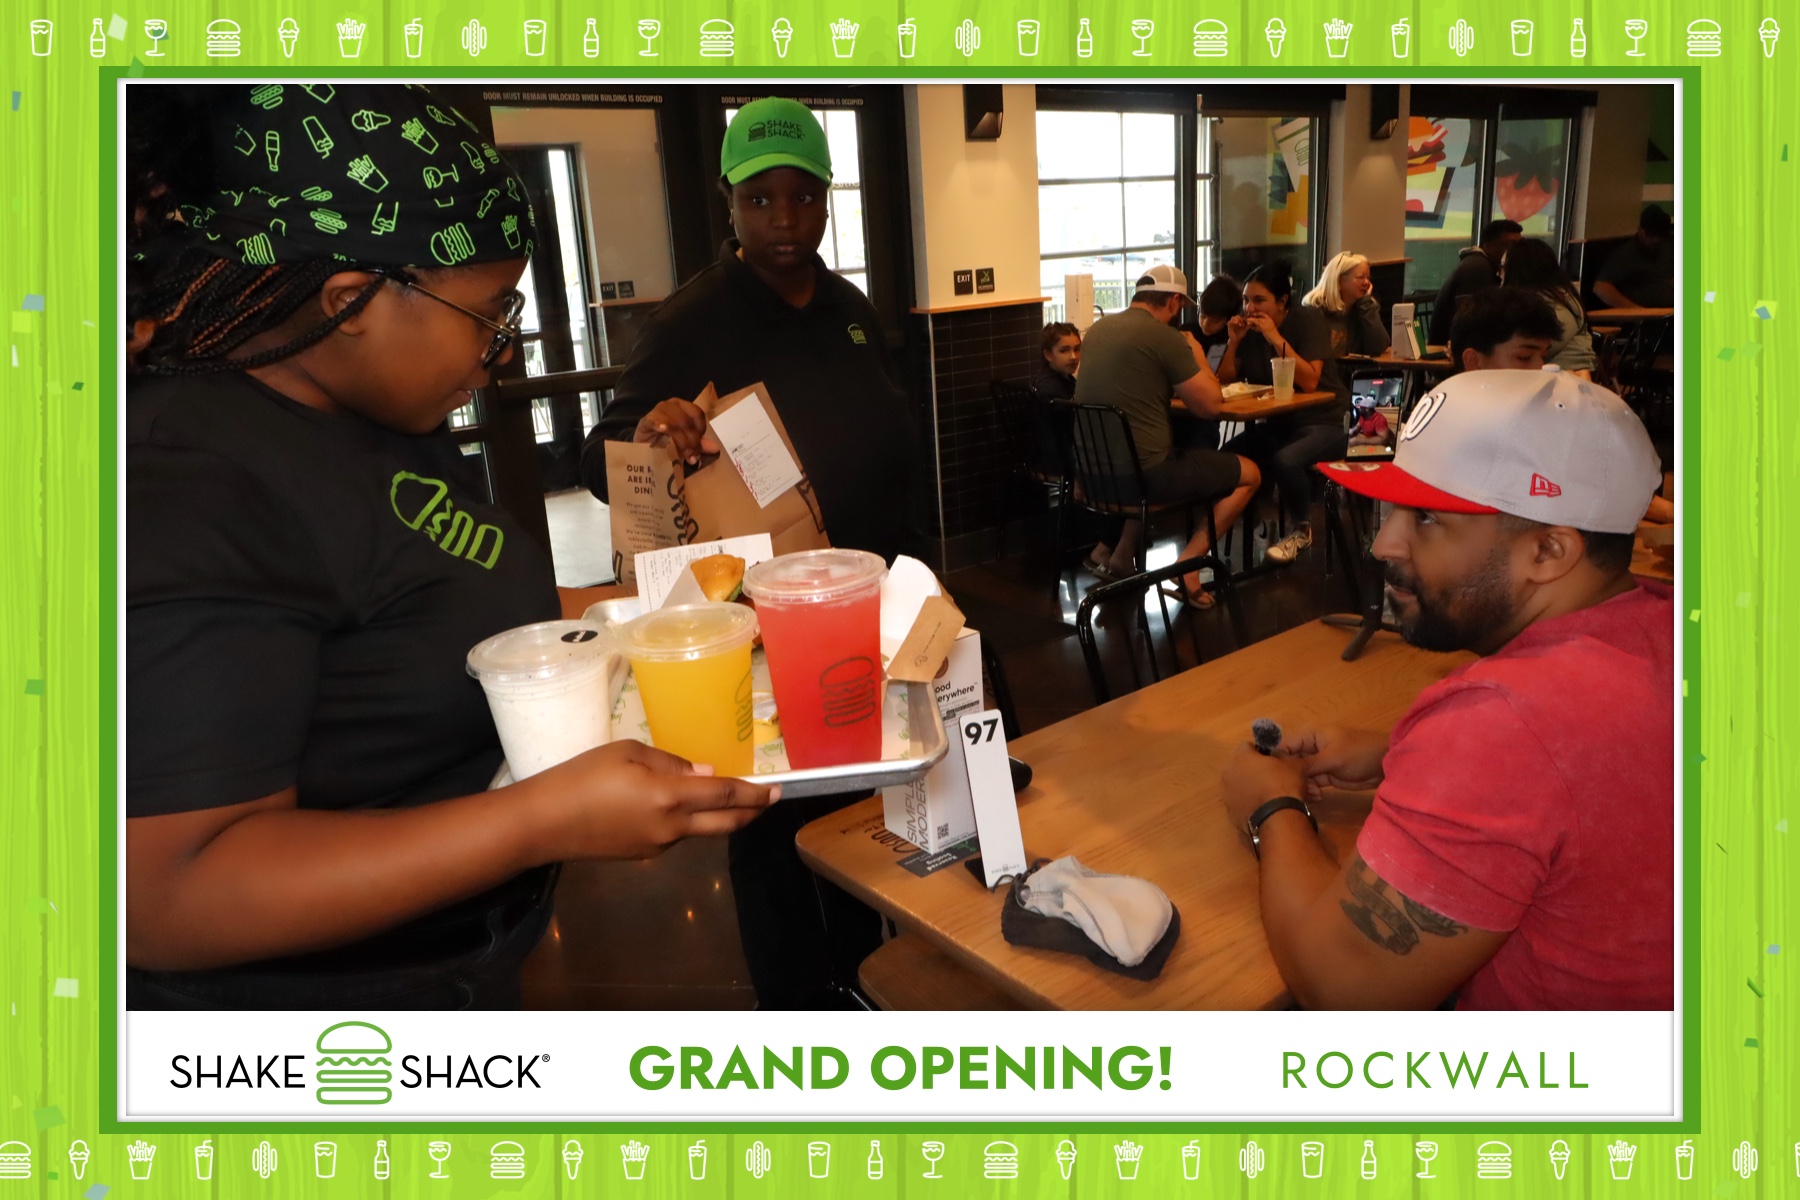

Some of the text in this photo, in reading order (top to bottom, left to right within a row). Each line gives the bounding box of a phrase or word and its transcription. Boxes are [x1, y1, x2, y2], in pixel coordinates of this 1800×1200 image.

[483, 92, 501, 100] DOOR
[502, 92, 521, 101] MUST
[522, 92, 547, 101] REMAIN
[548, 93, 580, 101] UNLOCKED
[581, 93, 599, 102] WHEN
[600, 94, 628, 102] BUILDING
[635, 95, 663, 103] OCCUPIED
[721, 96, 736, 104] DOOR
[813, 97, 835, 105] BUILDING
[841, 98, 864, 106] OCCUPIED
[766, 119, 802, 132] SHAKE
[767, 127, 804, 141] SHACK
[957, 274, 971, 283] EXIT
[626, 464, 645, 473] OUR
[627, 475, 643, 484] ARE
[935, 680, 951, 693] ood
[964, 718, 999, 746] 97
[915, 777, 929, 850] MODER
